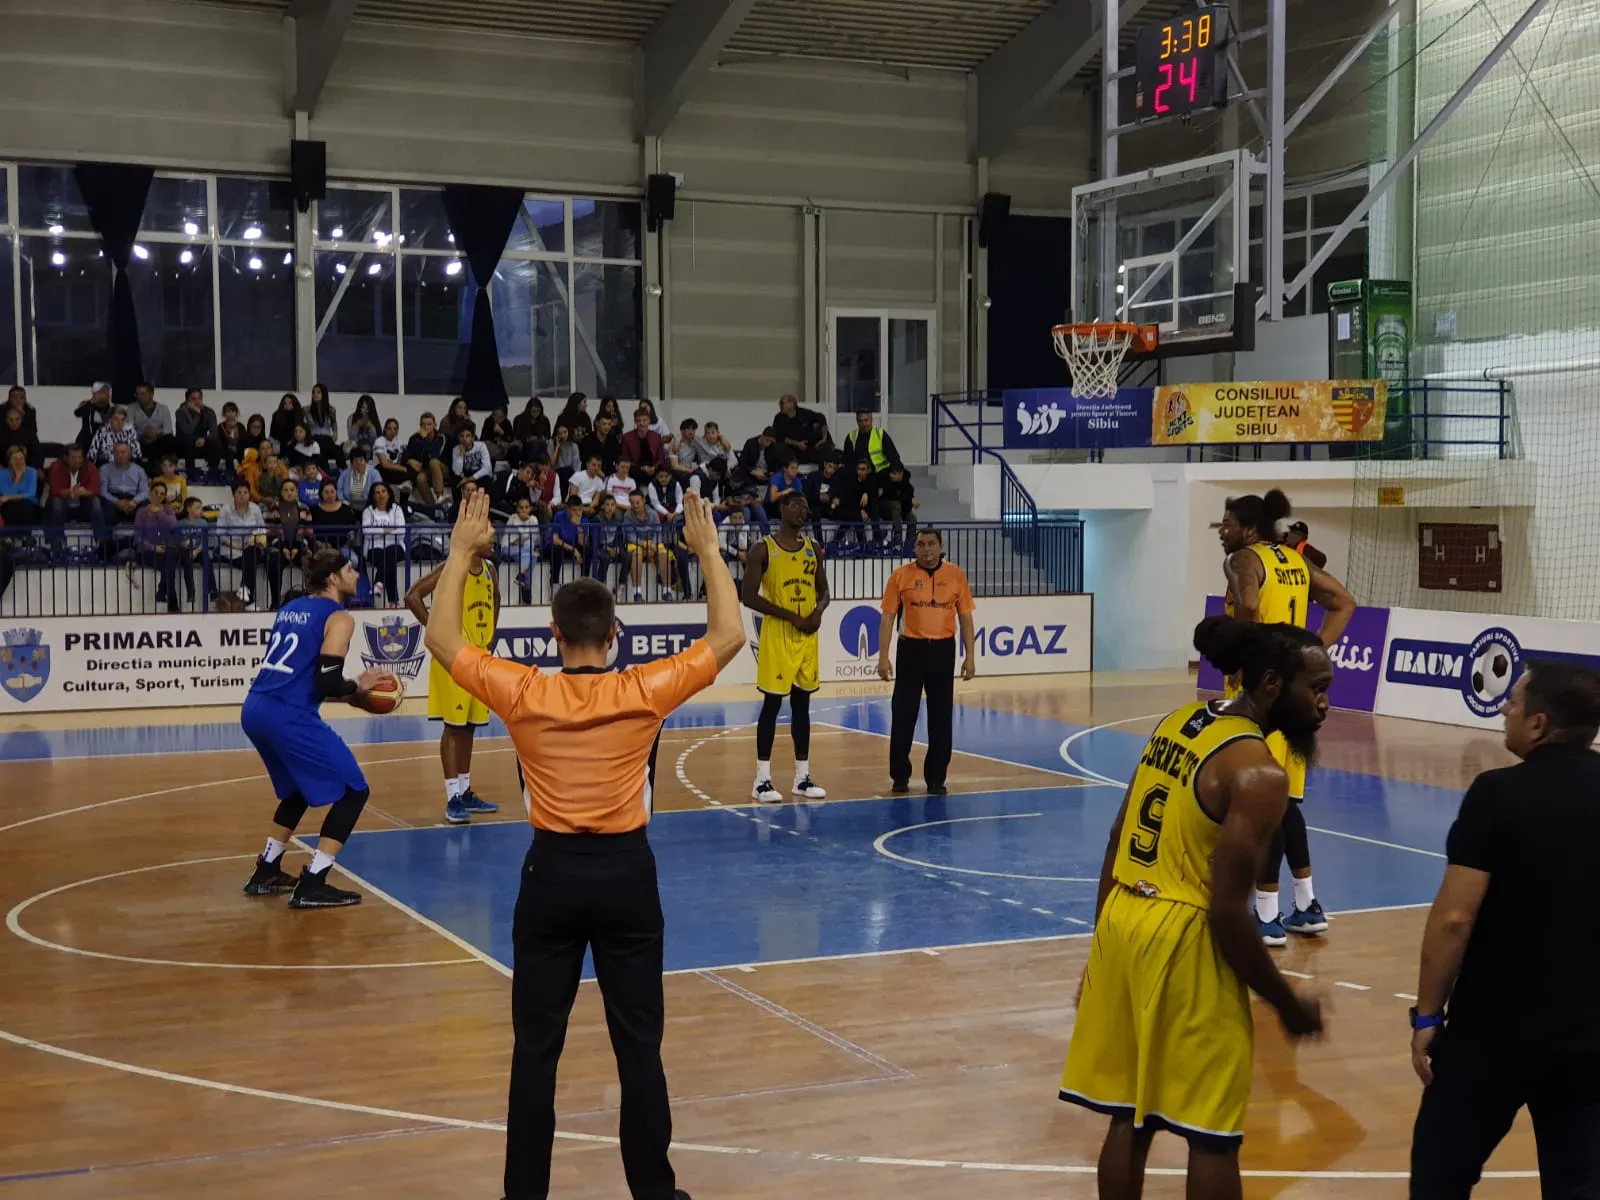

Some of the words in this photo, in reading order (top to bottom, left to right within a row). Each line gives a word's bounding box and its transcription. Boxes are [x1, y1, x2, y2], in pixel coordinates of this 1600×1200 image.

[1160, 14, 1211, 59] 3:38
[1155, 57, 1197, 113] 24
[1215, 387, 1300, 401] CONSILIUL
[1088, 418, 1119, 429] Sibiu
[1236, 423, 1278, 436] SIBIU
[802, 560, 816, 576] 22
[1274, 567, 1307, 586] SMITH
[65, 630, 203, 651] PRIMARIA
[220, 628, 273, 646] MED
[492, 637, 558, 658] AUM
[261, 631, 299, 674] 22
[86, 658, 153, 671] Directia
[158, 655, 247, 670] municipala
[835, 665, 881, 677] ROMGA
[1394, 650, 1464, 678] BAUM
[63, 680, 130, 693] Cultura,
[135, 677, 185, 692] Sport,
[190, 676, 245, 688] Turism
[1128, 783, 1171, 868] 9
